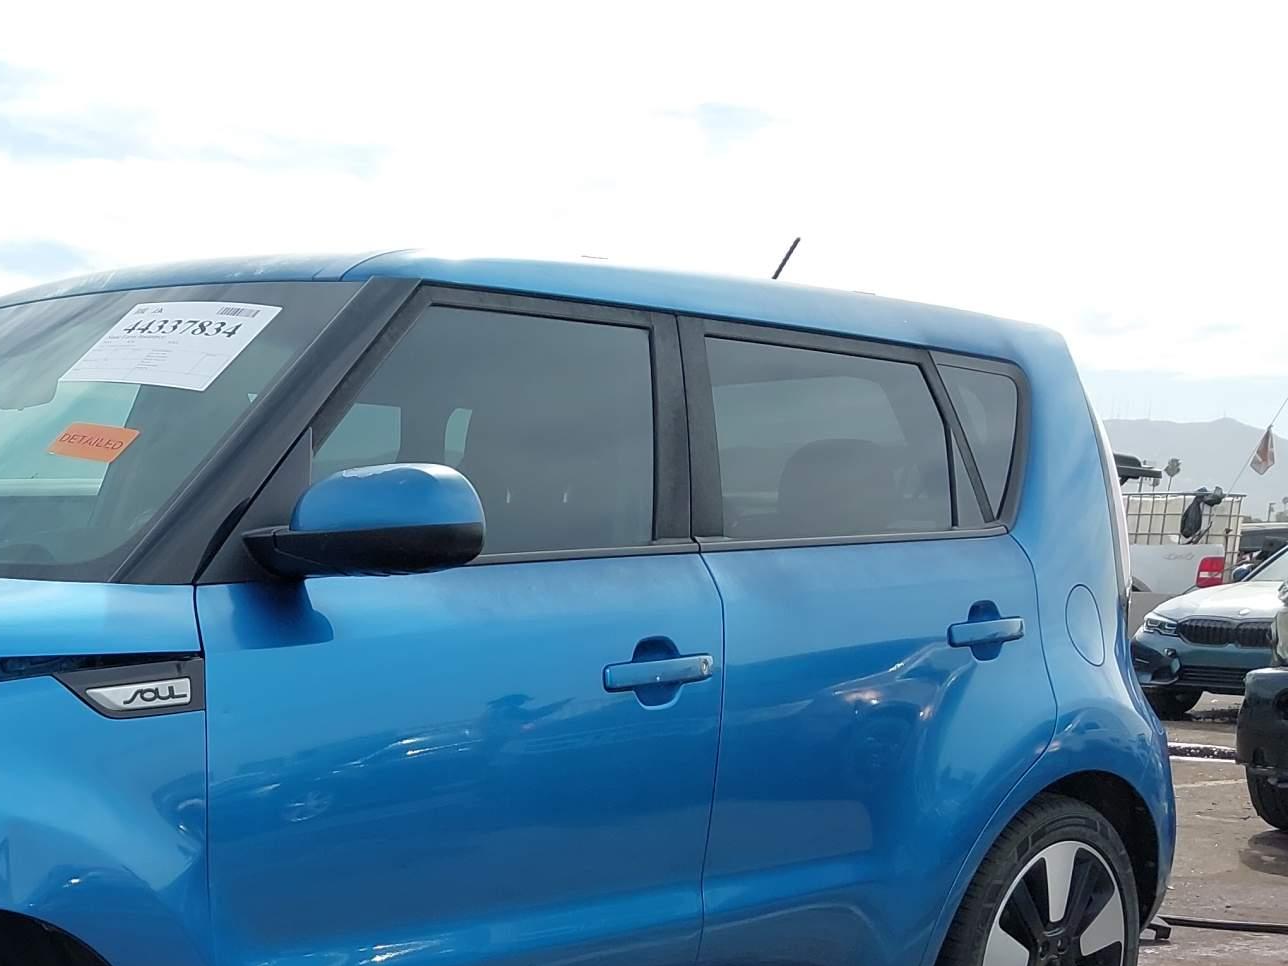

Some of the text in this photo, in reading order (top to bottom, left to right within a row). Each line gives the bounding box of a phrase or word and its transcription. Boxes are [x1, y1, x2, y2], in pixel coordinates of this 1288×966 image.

[123, 319, 243, 338] 44337834
[59, 432, 124, 450] DETAILED
[123, 685, 187, 705] SOUL
